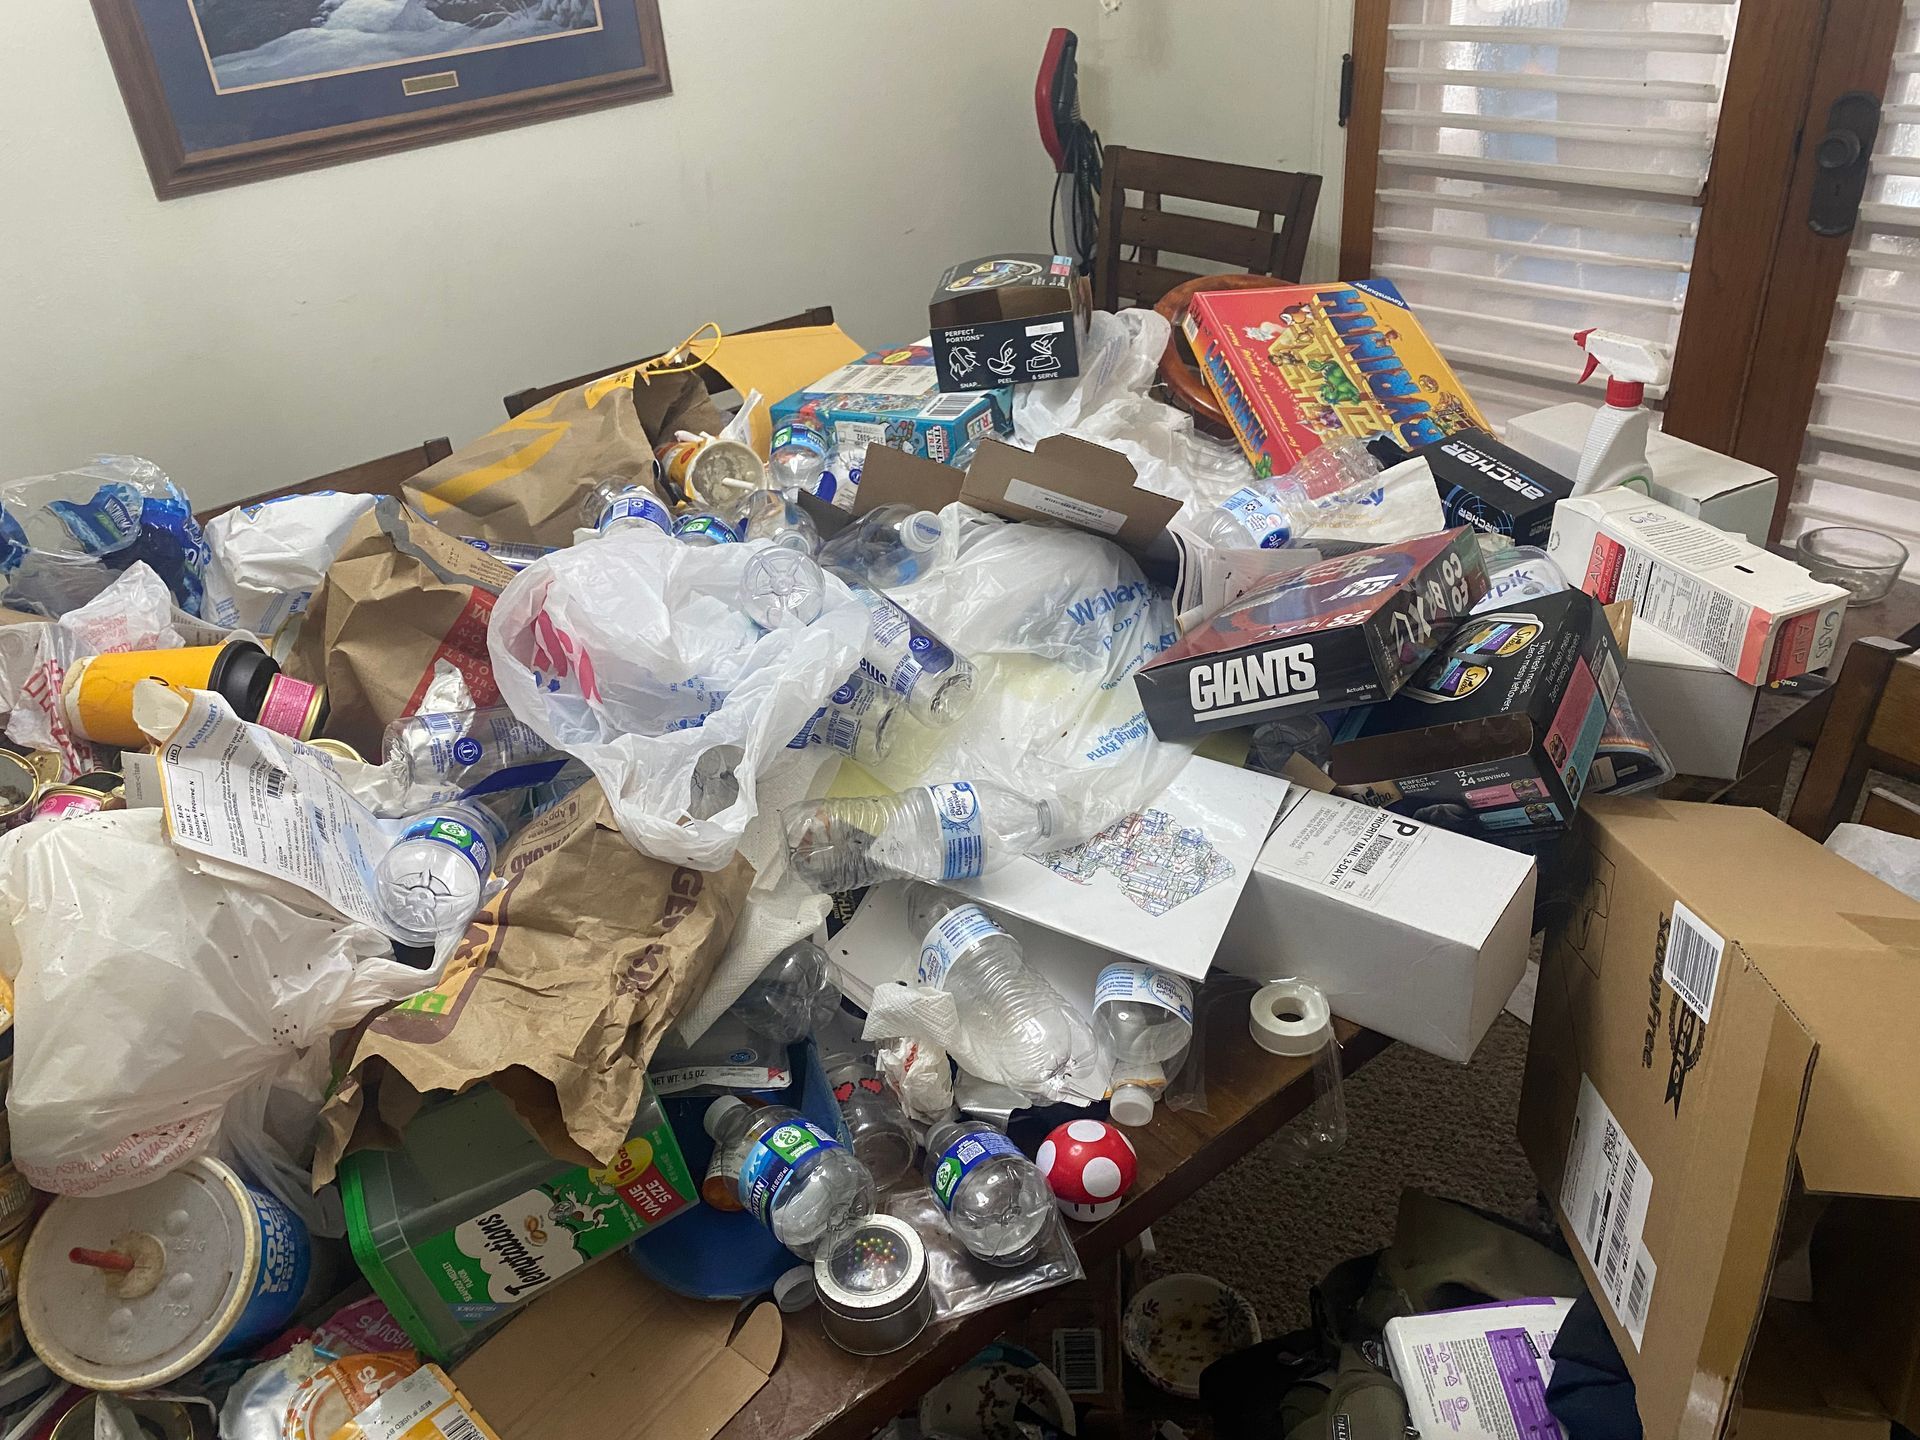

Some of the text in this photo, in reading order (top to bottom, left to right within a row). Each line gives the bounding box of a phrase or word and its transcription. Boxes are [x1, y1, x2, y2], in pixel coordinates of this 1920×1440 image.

[1355, 281, 1405, 307] Ravensburger
[944, 328, 975, 337] PERFECT
[1037, 371, 1059, 380] SERVE
[1314, 289, 1445, 452] BYRINTH
[1525, 641, 1540, 660] Zero
[1189, 642, 1317, 712] GIANTS
[1513, 657, 1531, 682] messy
[1520, 639, 1551, 695] Two fresh meals
[1346, 682, 1377, 694] Actual Size
[186, 703, 218, 750] Walmart
[1086, 721, 1148, 761] PLEASE RETURN
[170, 748, 178, 761] HD
[1398, 777, 1428, 787] PERFECT
[1454, 770, 1467, 778] 12
[1459, 771, 1511, 787] 24 SERVINGS
[1364, 812, 1389, 841] PRIORITY
[1392, 819, 1420, 837] P
[1347, 837, 1367, 858] MAIL
[652, 1075, 665, 1087] NET
[628, 1184, 661, 1217] VALUE
[645, 1179, 672, 1204] SIZE
[476, 1213, 552, 1296] Temptations
[394, 1412, 412, 1431] USED
[385, 1427, 397, 1440] BY
